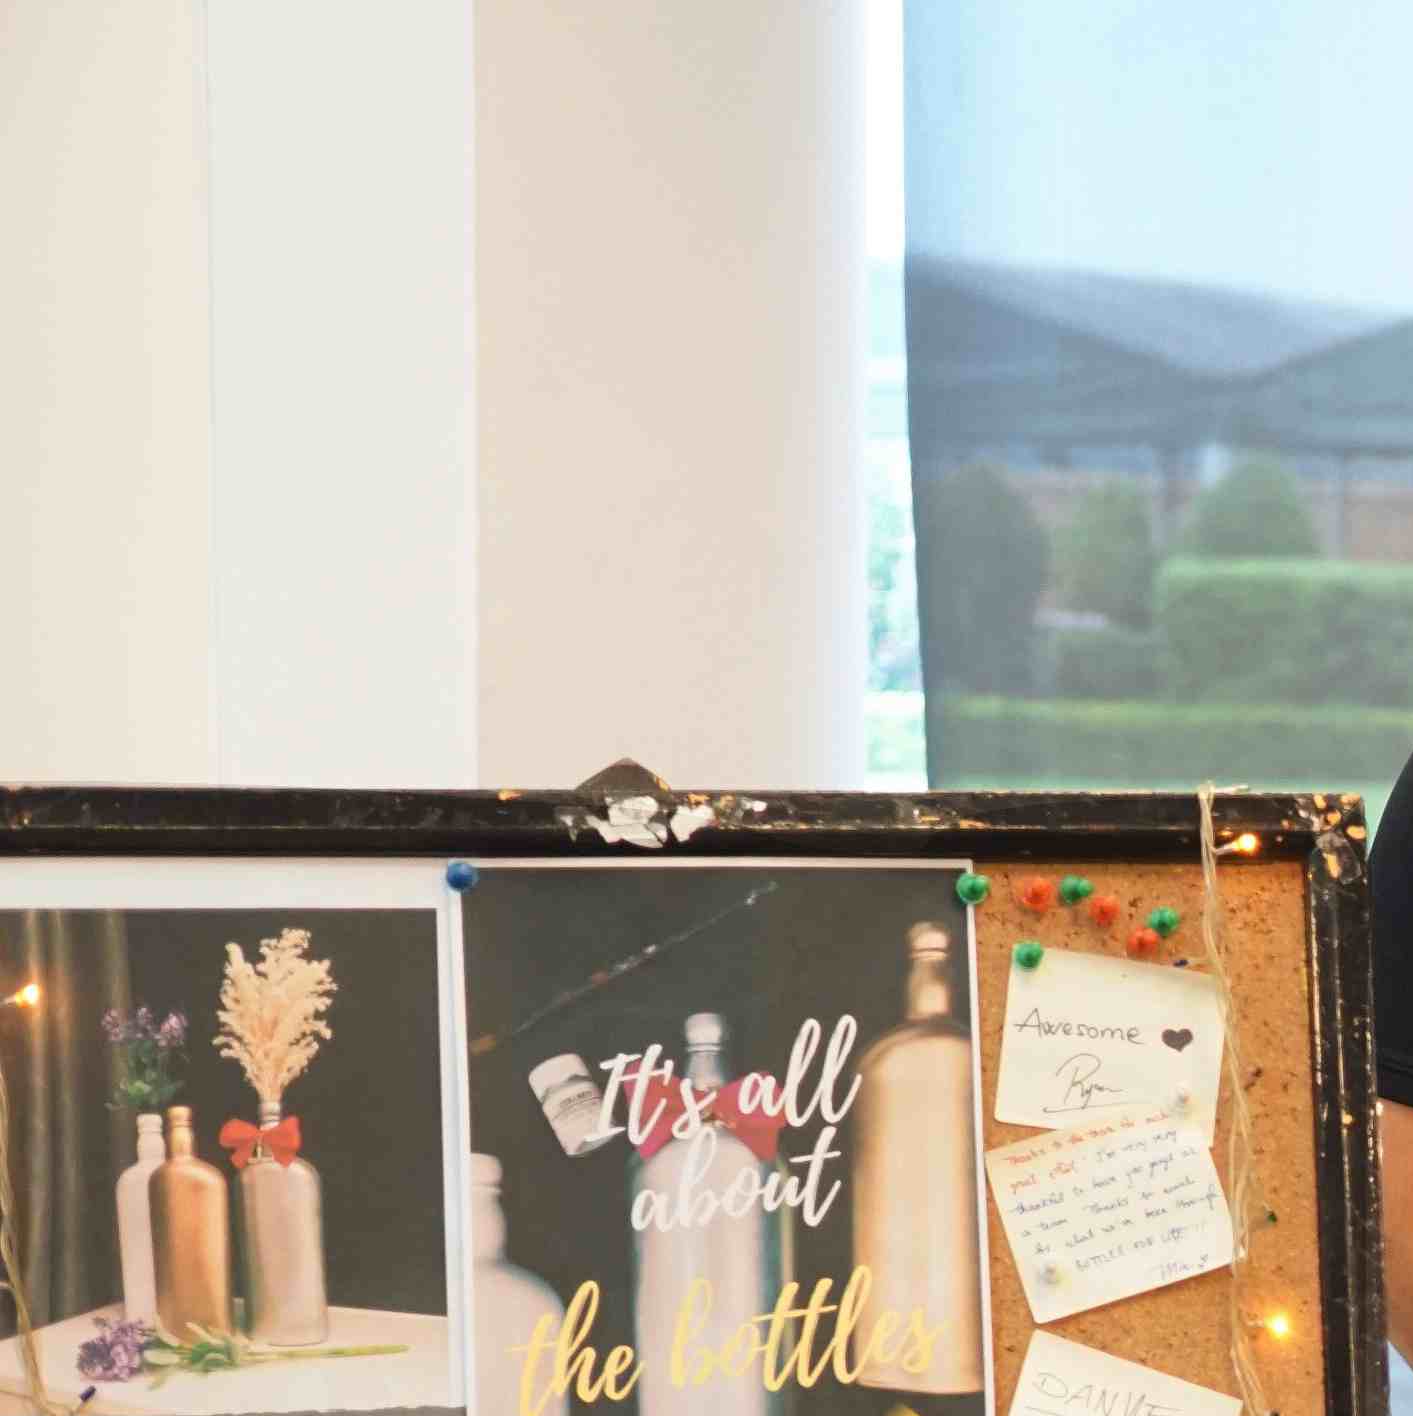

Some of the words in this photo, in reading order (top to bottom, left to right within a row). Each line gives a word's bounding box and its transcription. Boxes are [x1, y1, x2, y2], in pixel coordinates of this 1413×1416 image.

[583, 1043, 718, 1145] It's
[737, 1014, 863, 1129] all
[1013, 1007, 1145, 1045] Awesome
[630, 1125, 843, 1233] about
[671, 1265, 944, 1393] bottles
